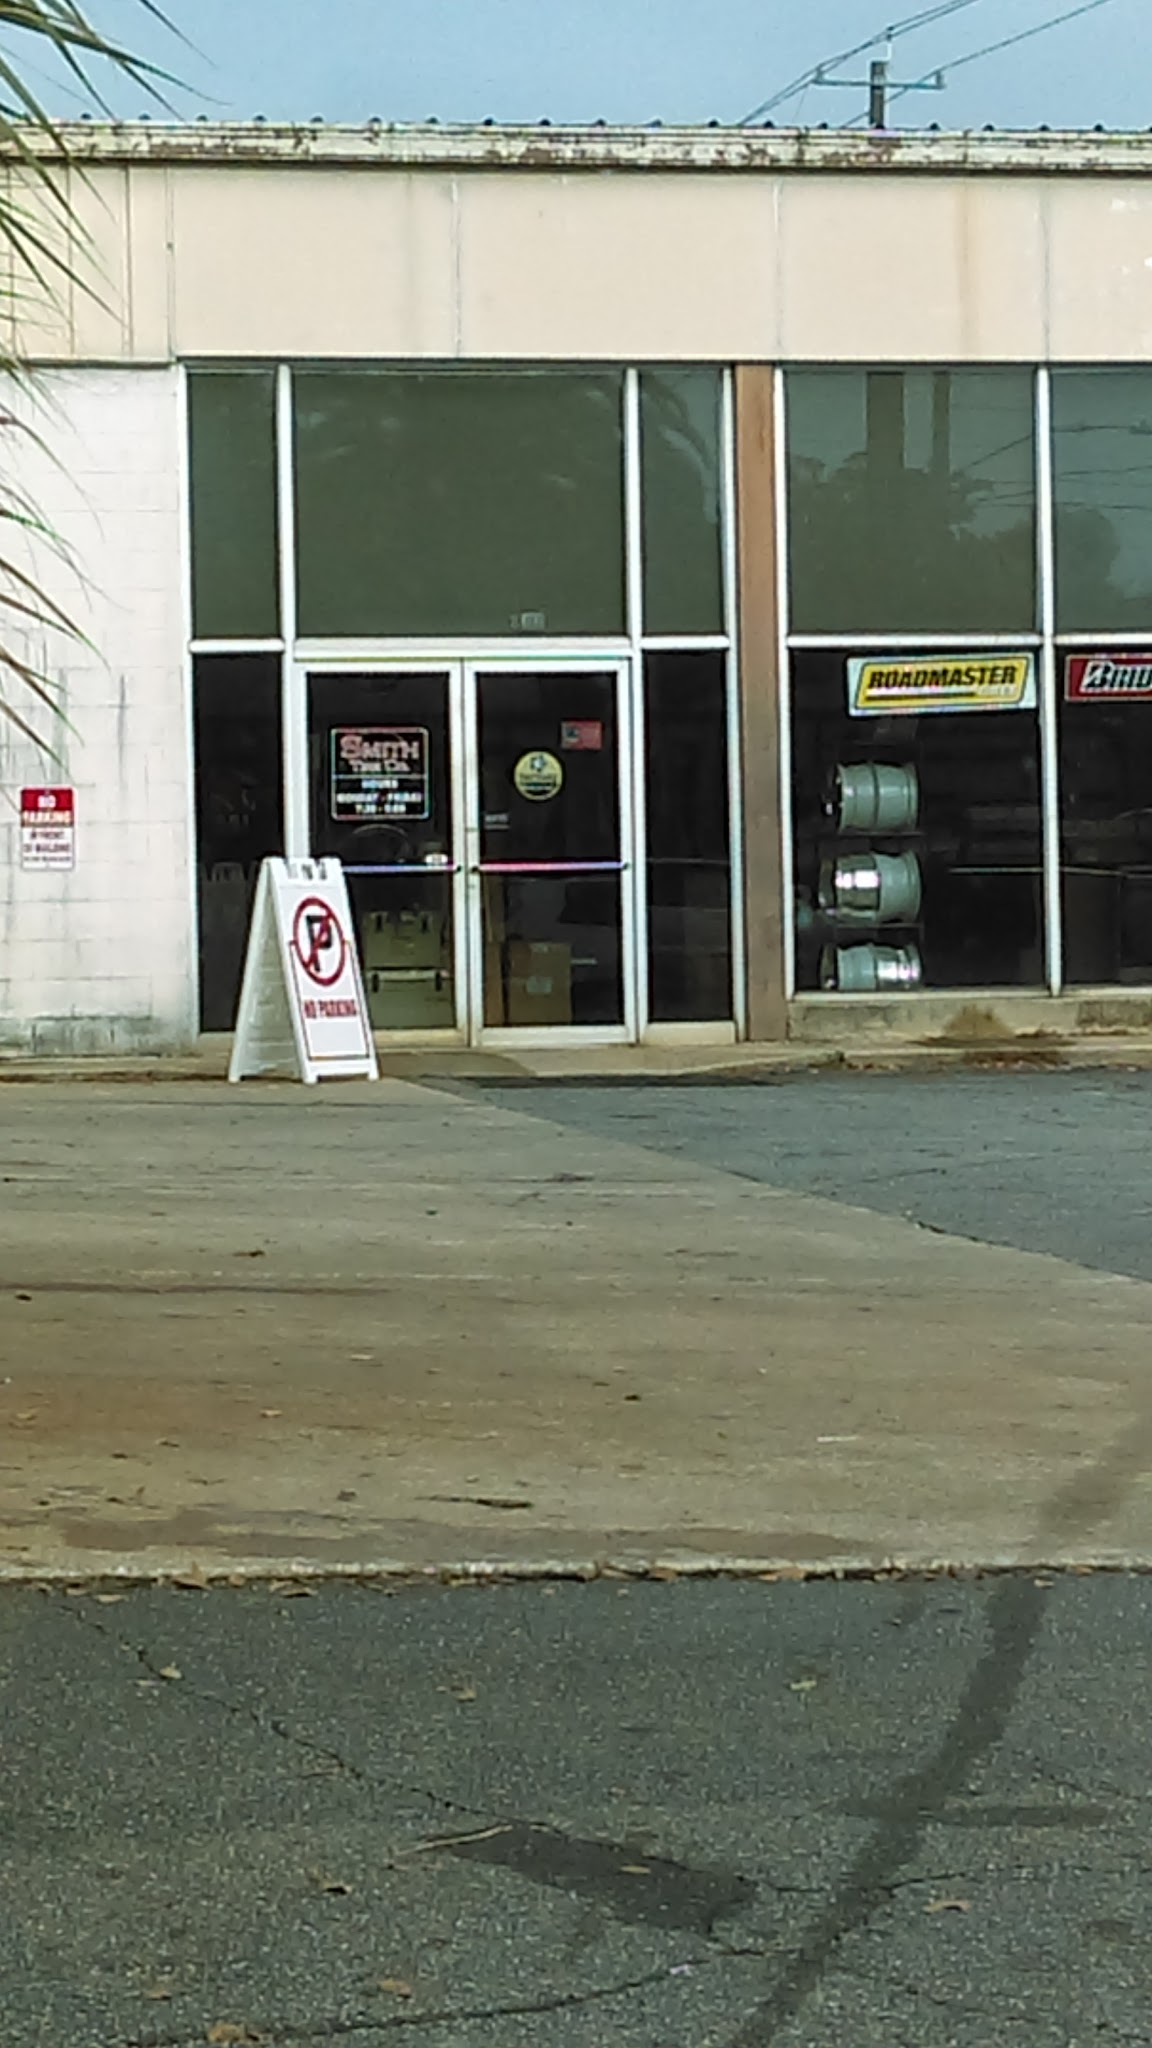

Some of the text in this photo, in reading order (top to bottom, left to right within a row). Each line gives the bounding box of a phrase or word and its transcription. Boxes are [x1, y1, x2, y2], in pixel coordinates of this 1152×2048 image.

[868, 665, 1017, 690] ROADMASTER
[340, 734, 420, 759] SMITH
[38, 795, 56, 809] NO
[304, 999, 358, 1019] NO PARKING
